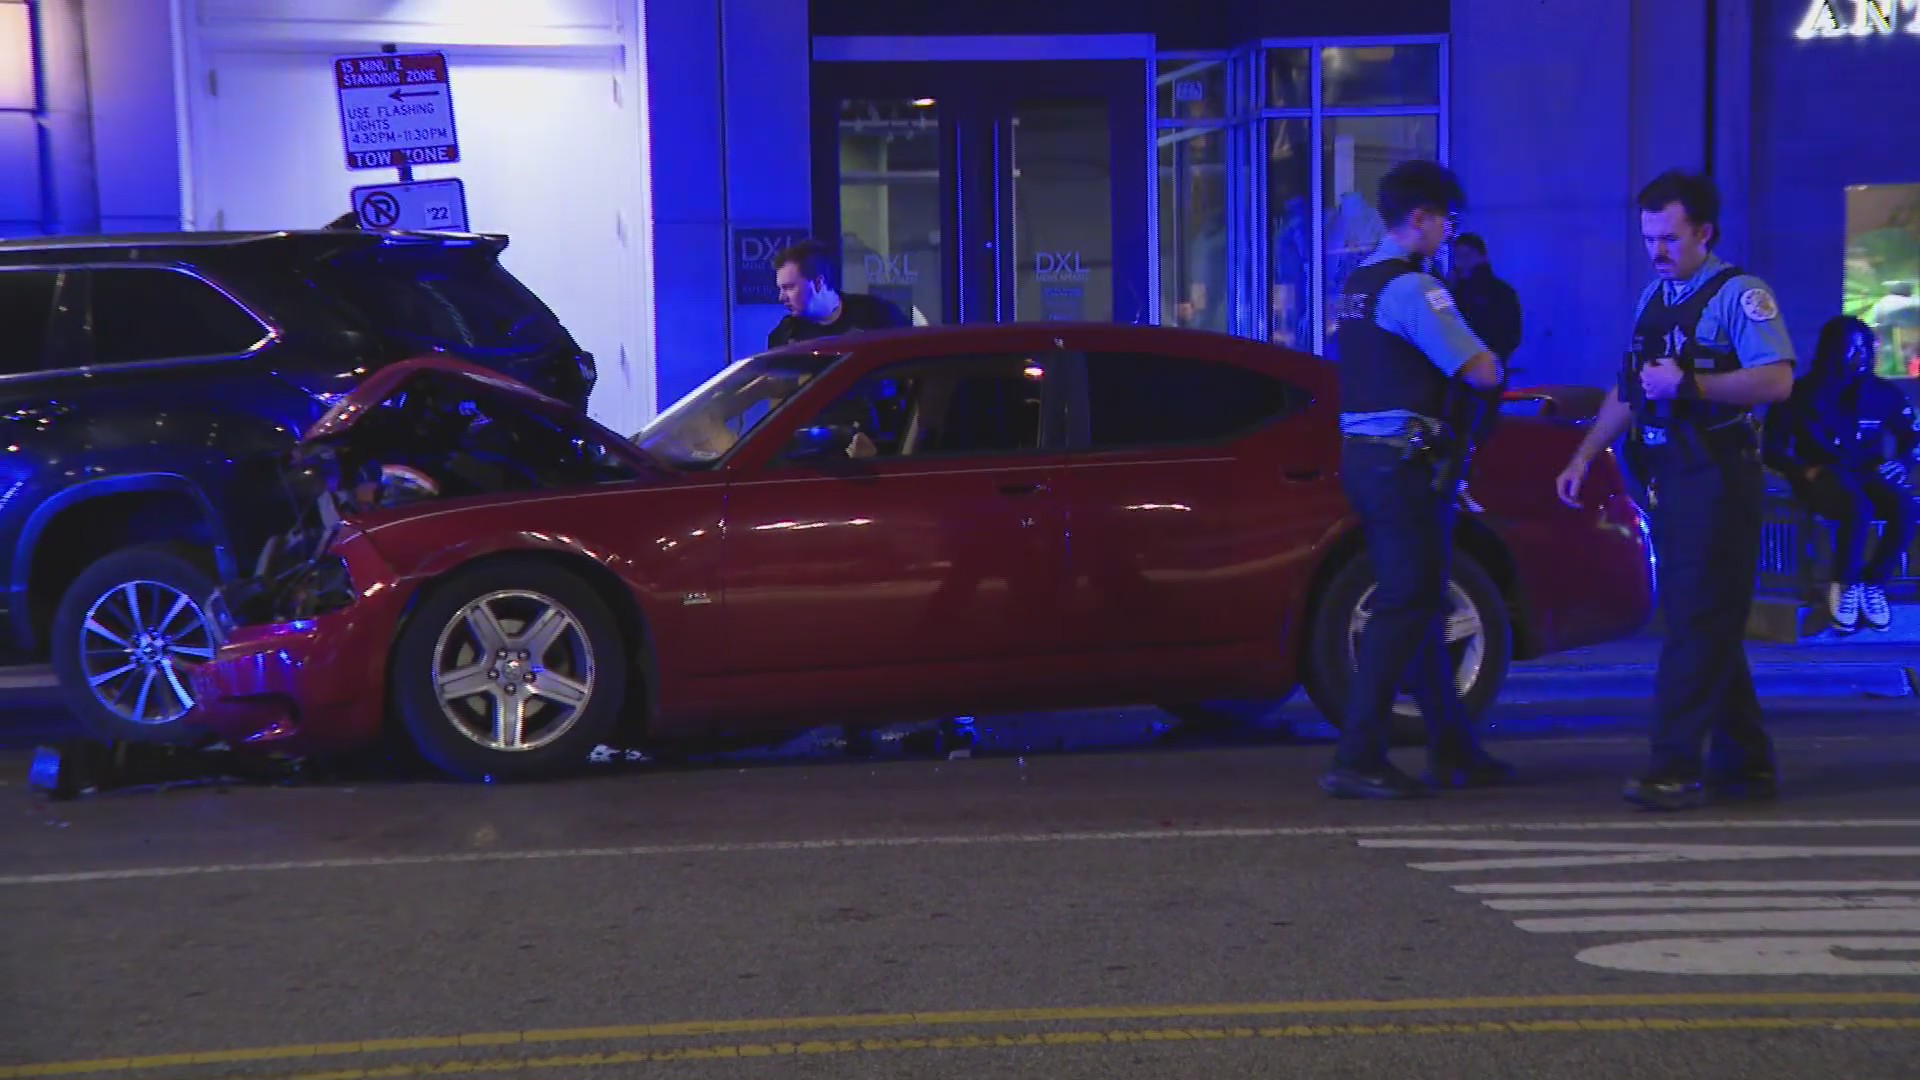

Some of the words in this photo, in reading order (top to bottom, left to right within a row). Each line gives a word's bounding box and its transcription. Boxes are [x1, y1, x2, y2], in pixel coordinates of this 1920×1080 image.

[341, 60, 353, 74] 15
[359, 57, 403, 72] MINUE
[343, 71, 400, 86] STANDING
[406, 68, 437, 82] ZONE
[348, 106, 370, 119] USE
[377, 103, 435, 118] FLASHING
[350, 119, 390, 132] LIGHTS
[354, 151, 392, 167] TOW
[863, 253, 918, 276] DXL
[1035, 252, 1089, 273] DXL
